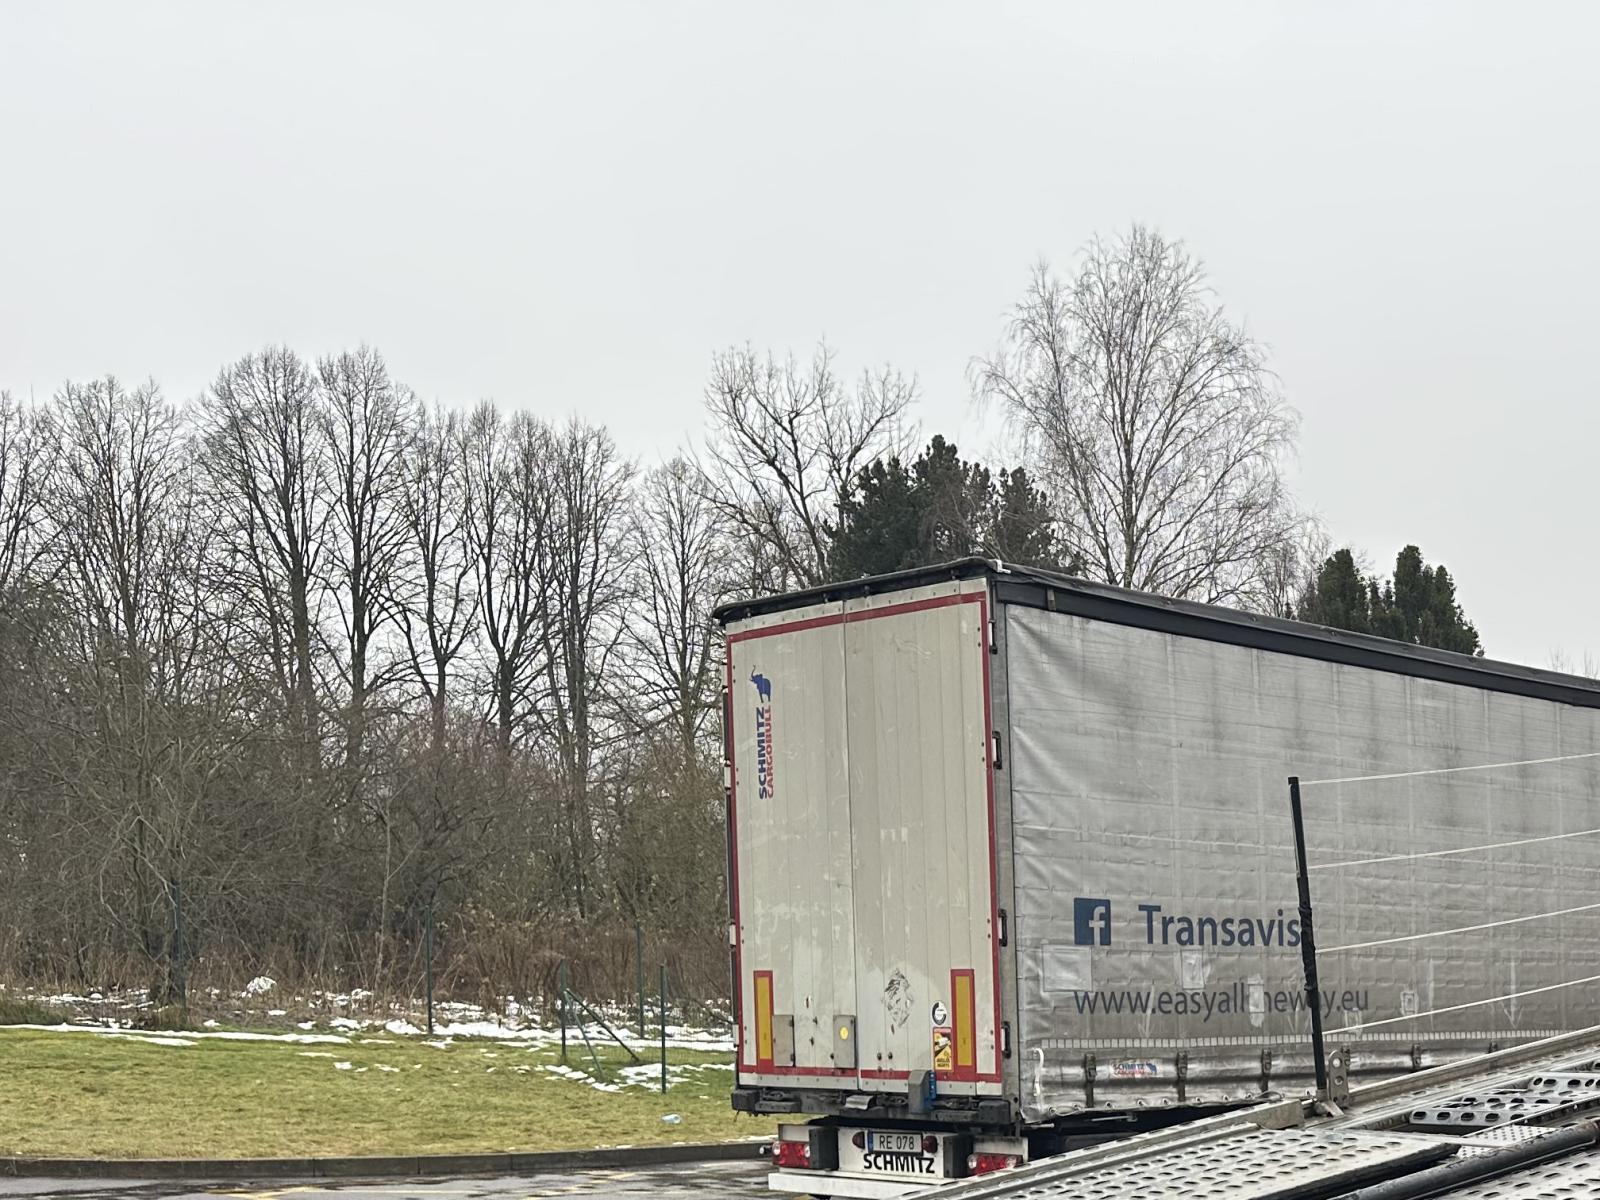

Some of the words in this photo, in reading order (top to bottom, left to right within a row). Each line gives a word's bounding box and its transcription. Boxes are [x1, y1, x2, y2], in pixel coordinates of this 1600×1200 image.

[756, 706, 767, 799] SCHMITZ
[1138, 904, 1301, 947] Transavis
[879, 1135, 893, 1150] RE
[896, 1135, 915, 1150] 078
[863, 1153, 935, 1174] SCHMITZ
